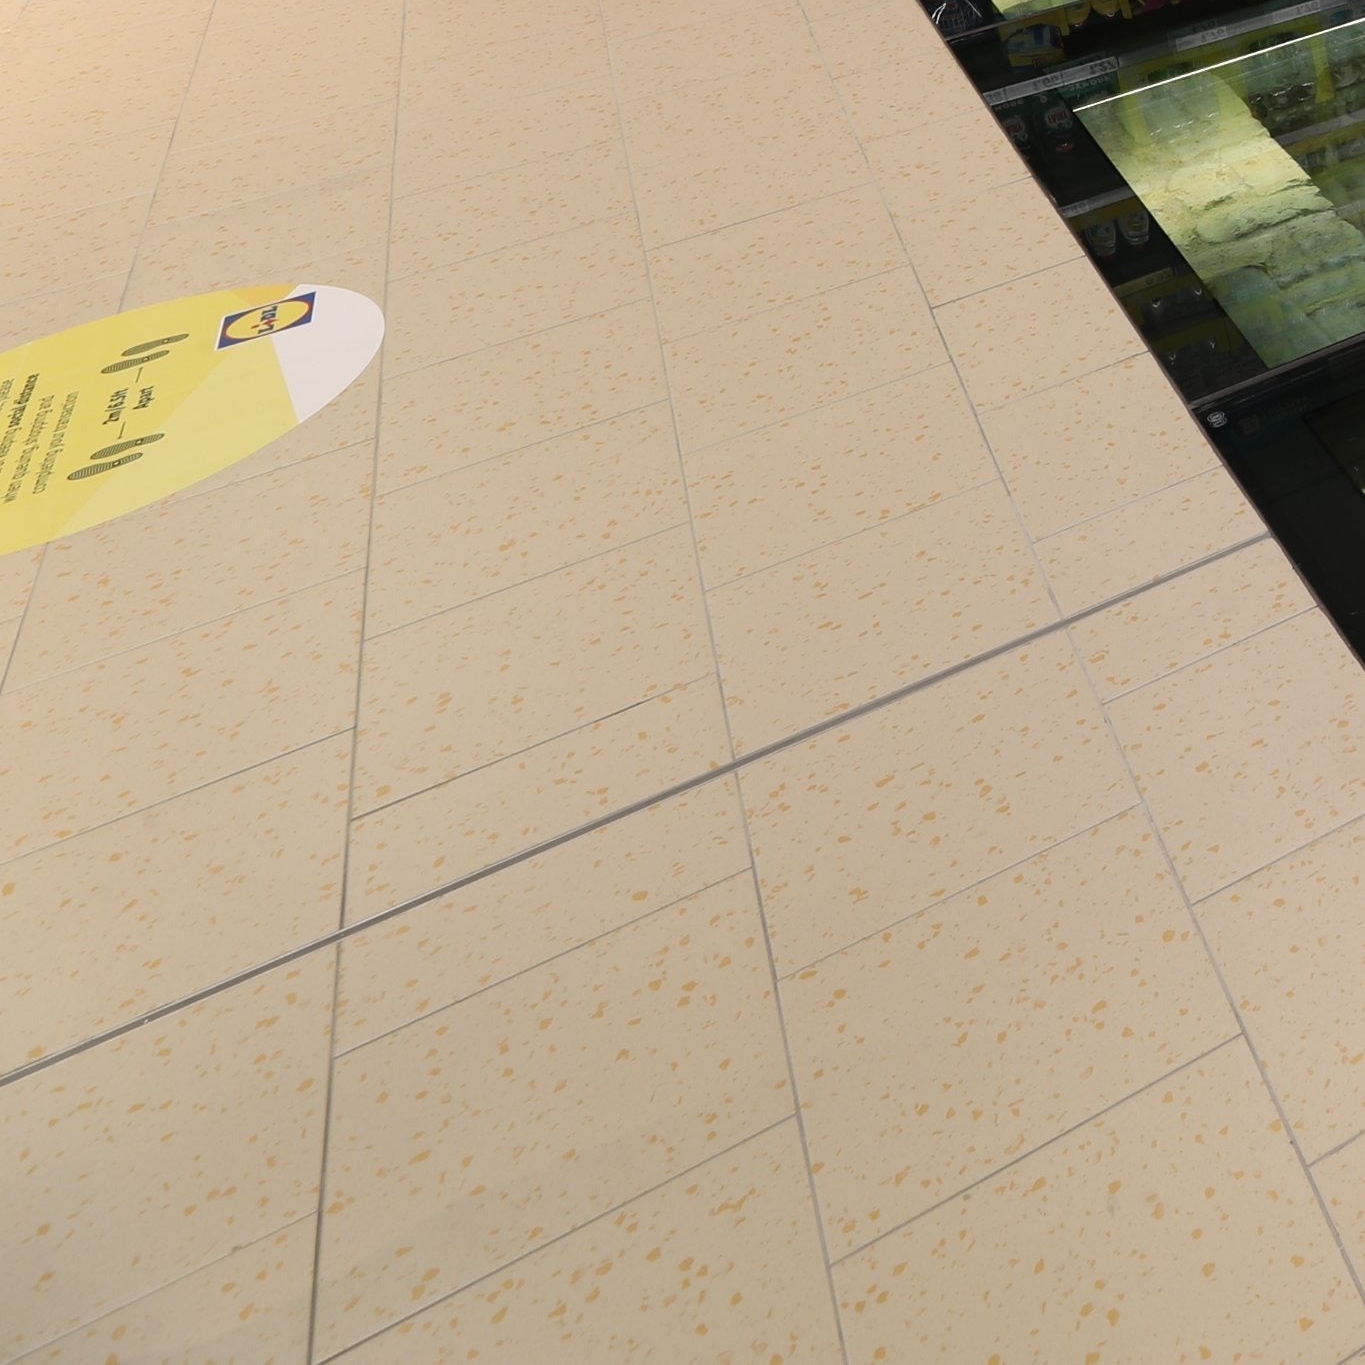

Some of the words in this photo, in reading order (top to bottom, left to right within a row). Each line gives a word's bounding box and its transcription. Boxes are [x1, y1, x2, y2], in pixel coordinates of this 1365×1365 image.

[14, 373, 40, 404] distance
[133, 386, 154, 410] Apart
[8, 405, 27, 428] social
